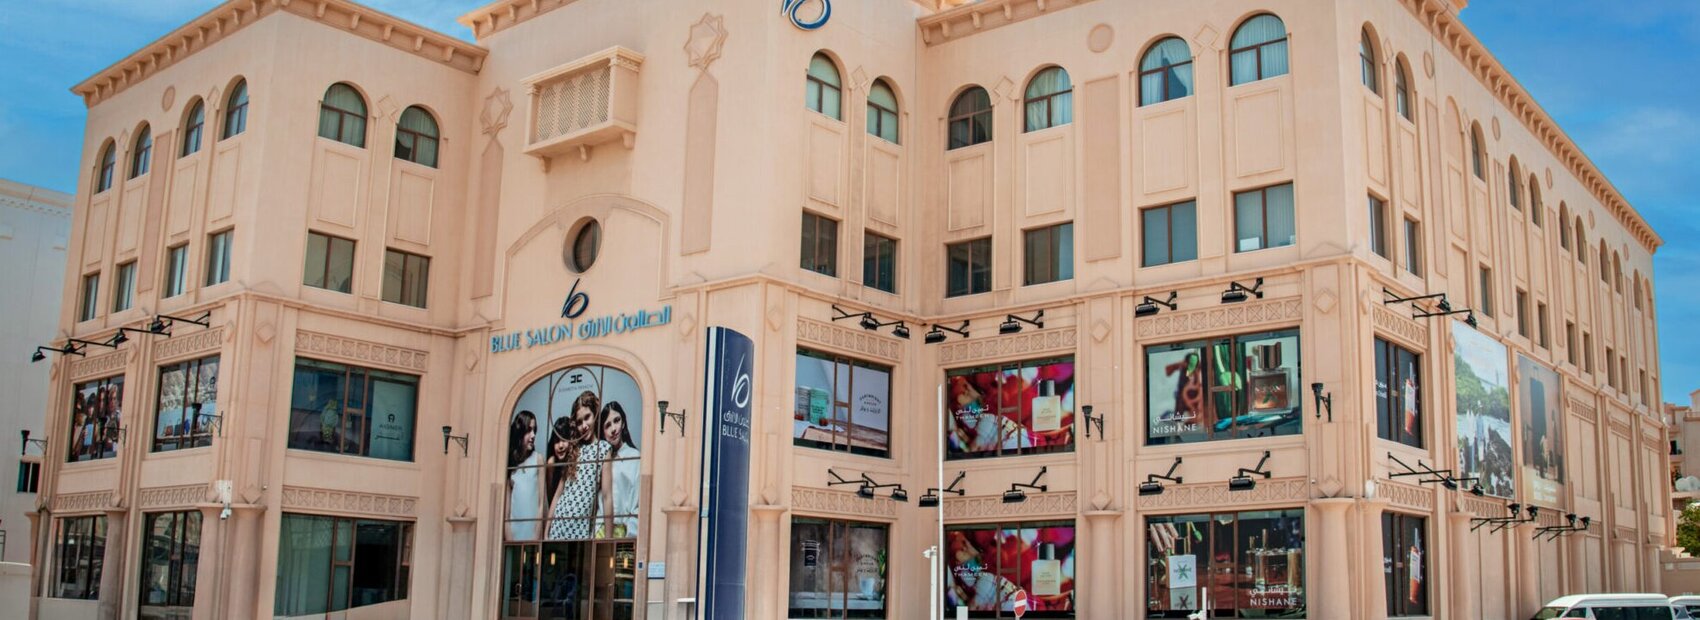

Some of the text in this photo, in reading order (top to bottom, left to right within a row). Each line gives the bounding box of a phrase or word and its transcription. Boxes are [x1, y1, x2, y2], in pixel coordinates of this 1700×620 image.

[491, 323, 574, 353] BLUE SALON
[722, 424, 739, 439] BLUE
[1153, 423, 1198, 434] NISHANE
[1250, 597, 1297, 606] NISHANE
